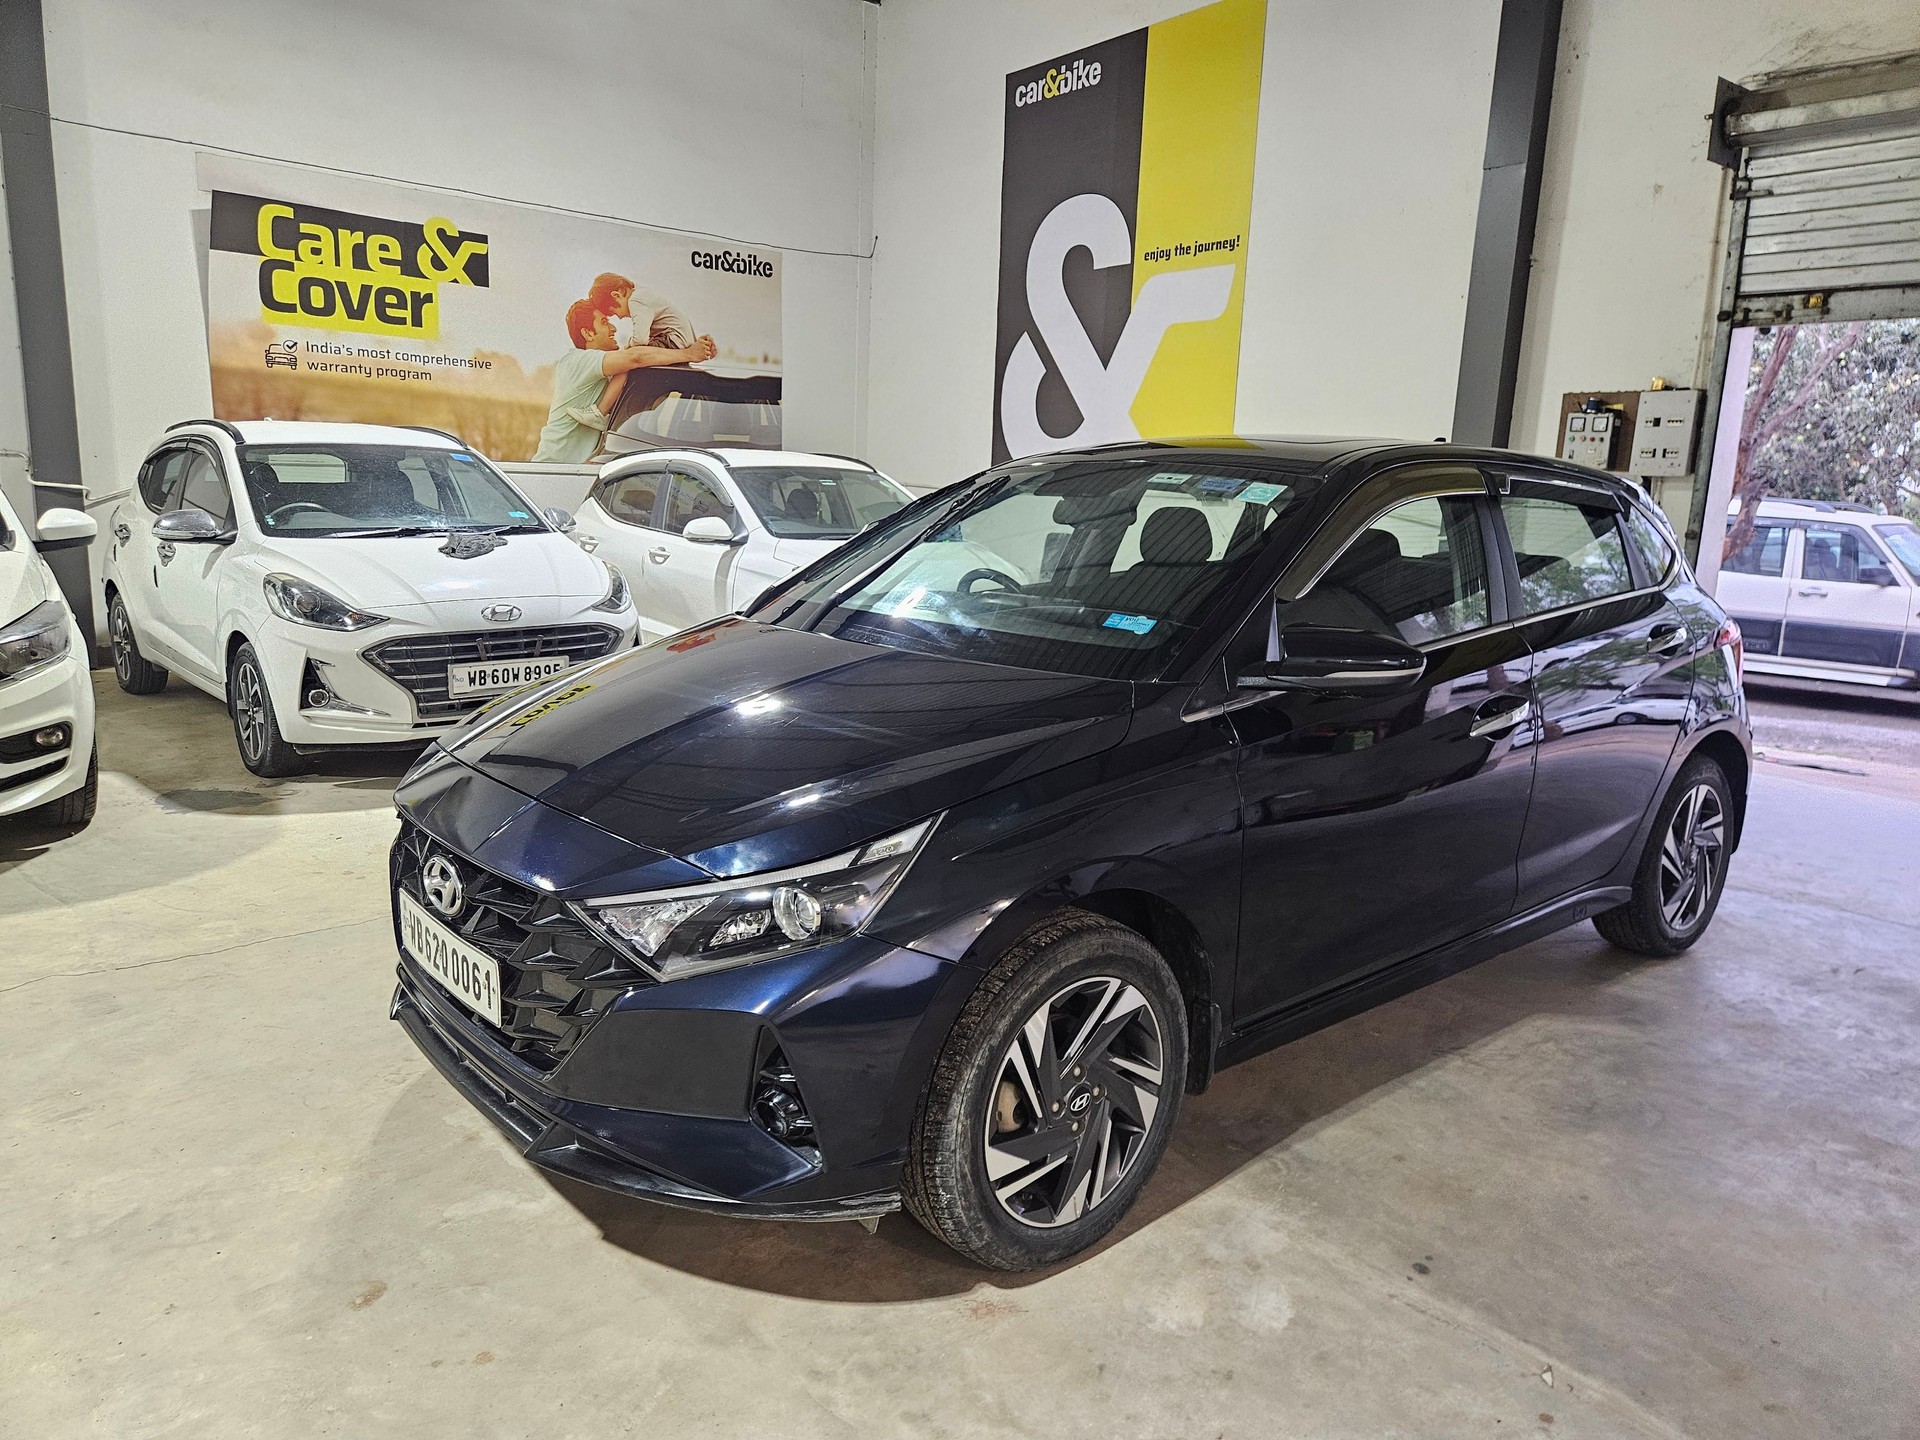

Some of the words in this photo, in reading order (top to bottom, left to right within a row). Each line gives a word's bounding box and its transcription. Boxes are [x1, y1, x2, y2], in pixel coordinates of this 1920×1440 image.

[1015, 59, 1102, 108] car&bike
[257, 203, 402, 275] Care
[416, 216, 489, 286] &
[1144, 247, 1171, 263] enjoy
[1174, 243, 1191, 257] the
[1193, 234, 1240, 257] journey!
[691, 250, 773, 278] car&bike
[259, 259, 434, 328] Cover
[307, 361, 372, 378] warranty
[376, 366, 432, 381] program
[357, 348, 391, 360] most
[395, 351, 492, 370] comprehensive
